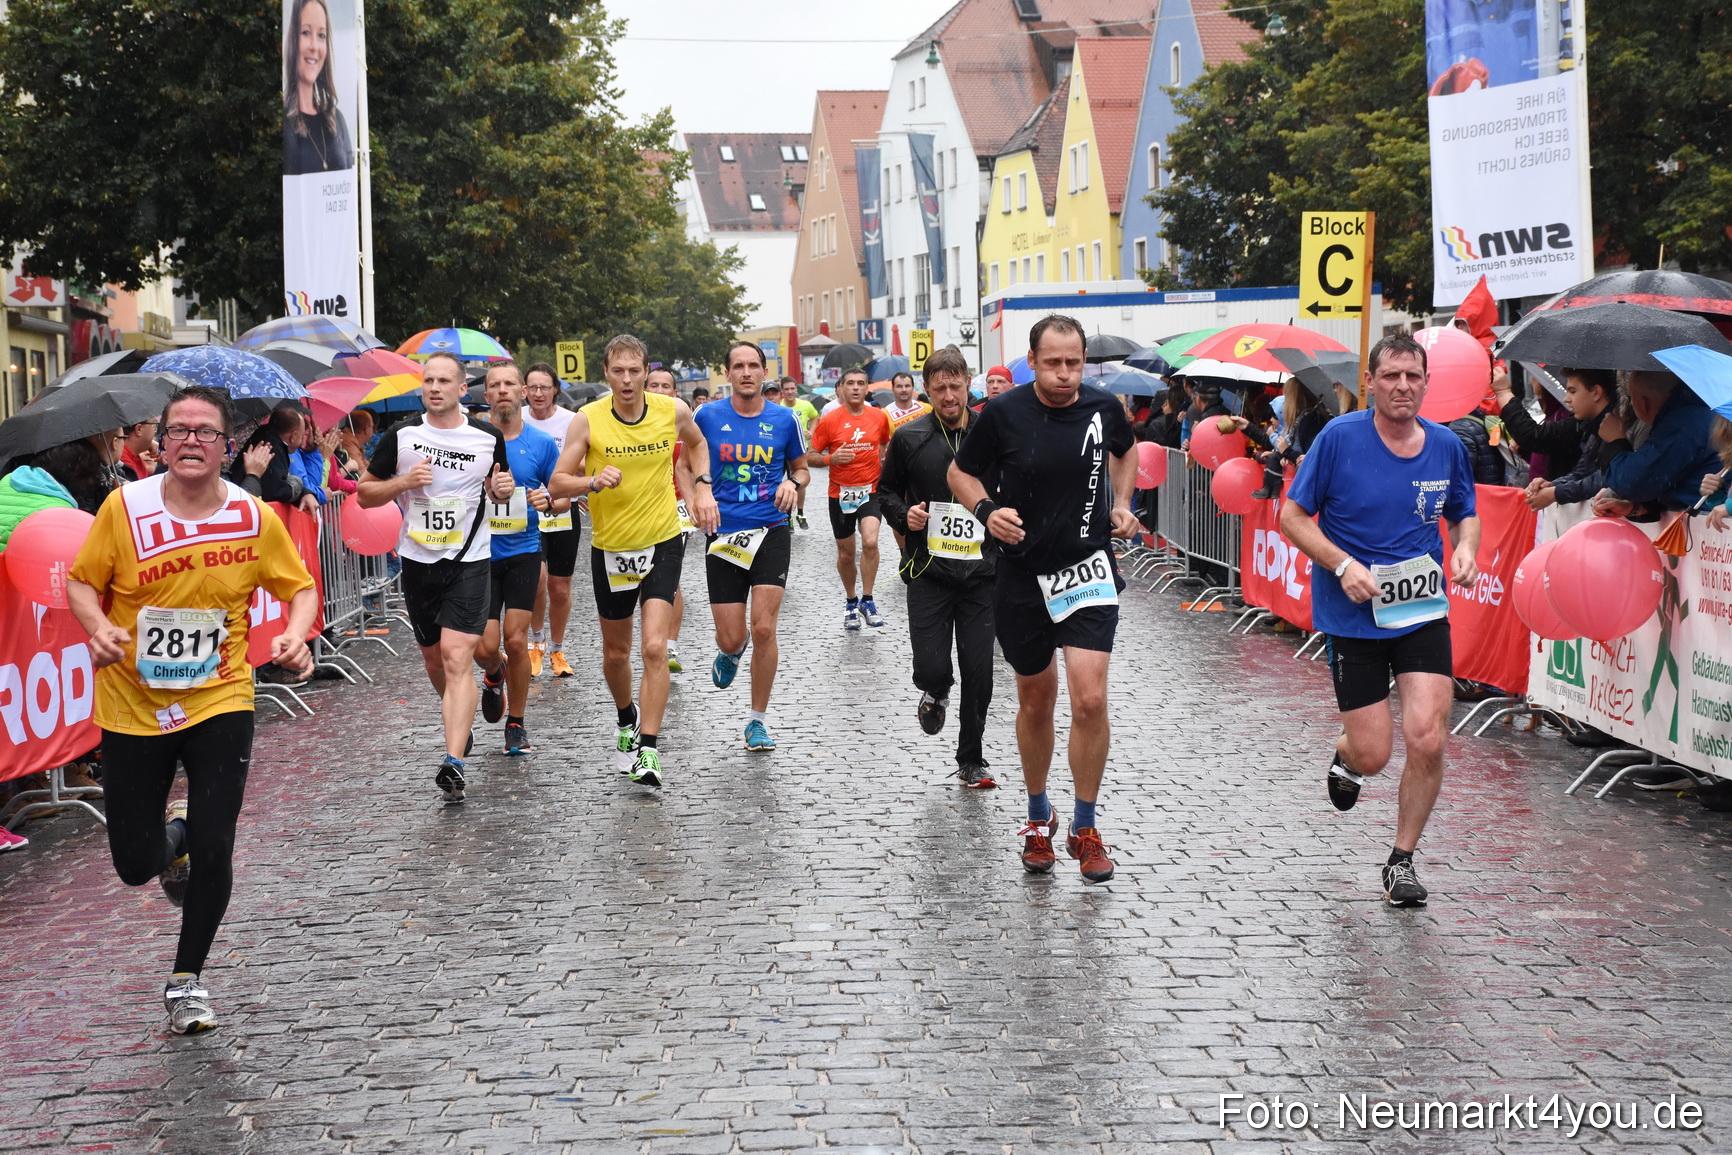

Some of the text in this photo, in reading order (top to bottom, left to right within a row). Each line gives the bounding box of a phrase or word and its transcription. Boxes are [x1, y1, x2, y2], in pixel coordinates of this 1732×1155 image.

[1310, 217, 1366, 235] Block
[1011, 232, 1030, 252] HOTEL
[1317, 244, 1355, 297] C
[911, 331, 932, 339] Block
[559, 343, 581, 352] Block
[915, 342, 928, 362] D
[564, 354, 578, 374] D
[423, 445, 477, 463] INTERSPORT
[605, 439, 670, 454] KLINGELE
[719, 443, 774, 465] RUN
[720, 464, 752, 483] AS
[842, 490, 869, 502] 214
[1080, 448, 1103, 538] RAIL.ONE
[421, 510, 456, 531] 155
[490, 520, 512, 529] Maher
[940, 515, 975, 540] 353
[425, 534, 447, 543] David
[941, 541, 970, 553] Norbert
[138, 545, 260, 587] MAX BÖGL
[615, 555, 648, 574] 342
[1046, 556, 1108, 597] 2206
[1063, 587, 1101, 607] Thomas
[1379, 569, 1439, 605] 3020
[146, 627, 220, 659] 2811
